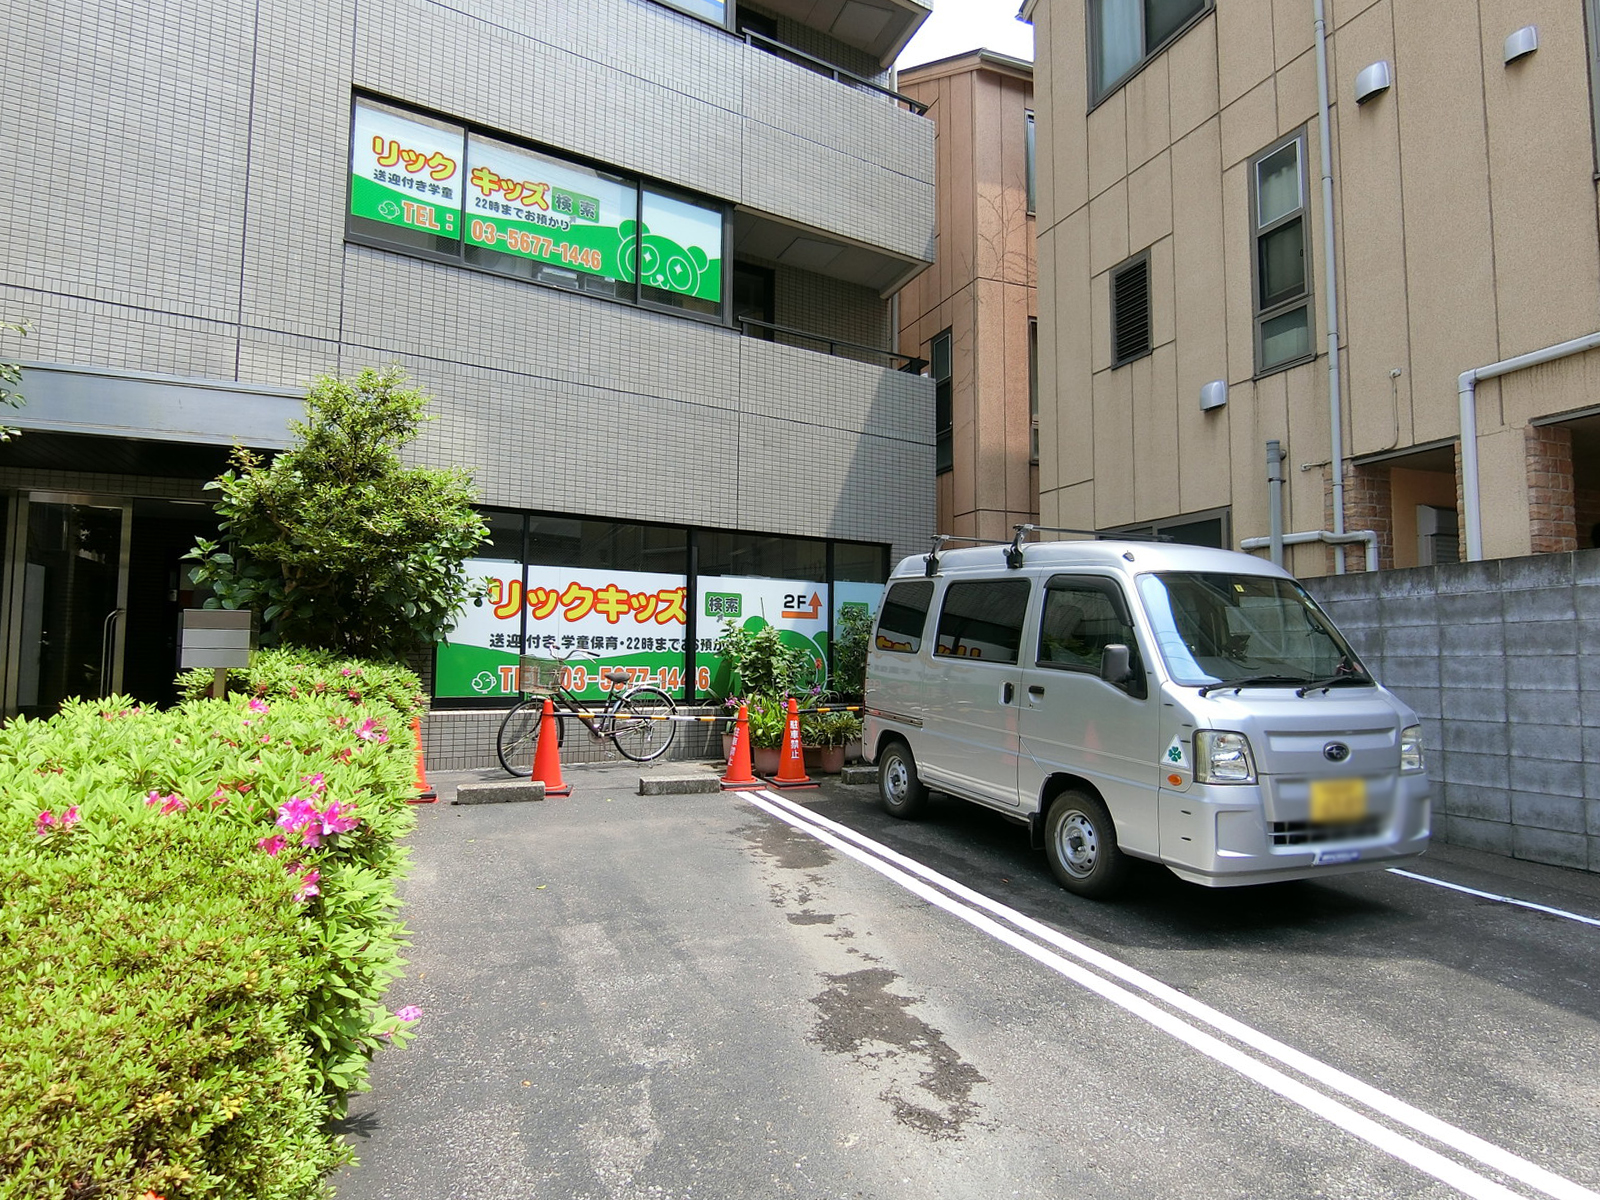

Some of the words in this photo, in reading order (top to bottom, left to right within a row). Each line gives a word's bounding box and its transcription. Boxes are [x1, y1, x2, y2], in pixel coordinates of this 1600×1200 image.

[373, 135, 457, 181] リック
[471, 166, 550, 211] キッズ
[373, 168, 454, 200] 送迎付き学童
[475, 196, 571, 231] 22時までお預かり
[554, 193, 597, 219] 検索
[471, 219, 602, 270] 03-5677-1446
[488, 577, 687, 625] リックキッズ
[709, 596, 739, 613] 検索
[783, 594, 807, 609] 2F
